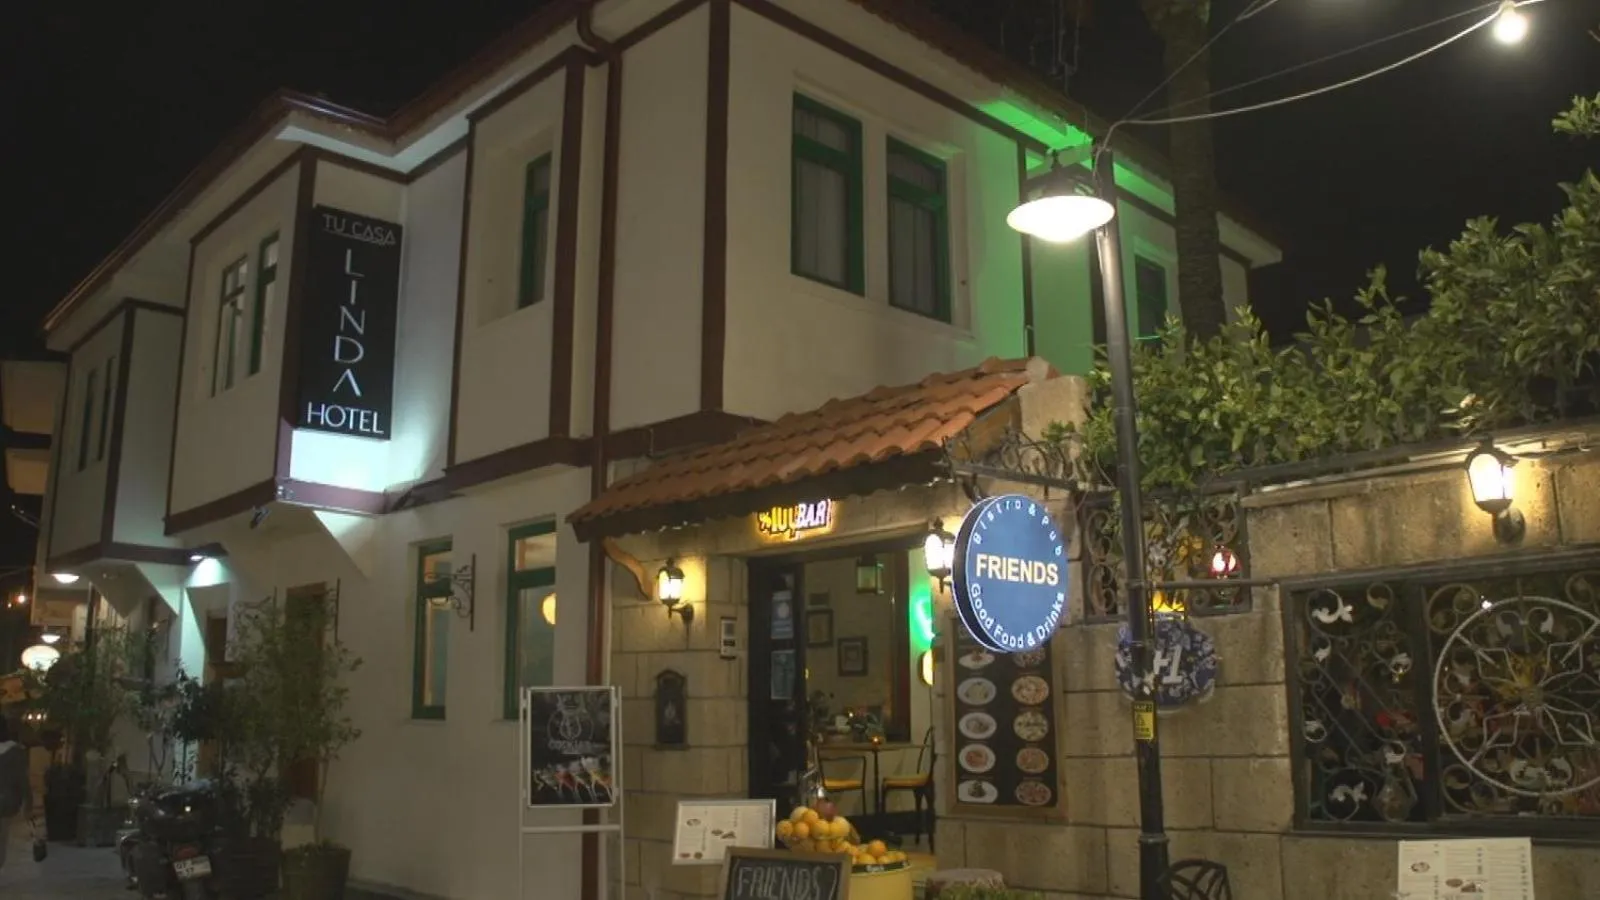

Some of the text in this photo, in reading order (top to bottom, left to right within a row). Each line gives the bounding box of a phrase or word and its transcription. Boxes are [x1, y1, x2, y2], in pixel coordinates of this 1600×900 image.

[322, 213, 396, 246] TU CASA
[332, 249, 366, 396] LINDA
[307, 402, 385, 434] HOTEL
[798, 500, 827, 528] BAR
[1028, 503, 1036, 517] &
[976, 553, 1059, 586] FRIENDS
[971, 583, 1065, 649] Good Food & Drinks
